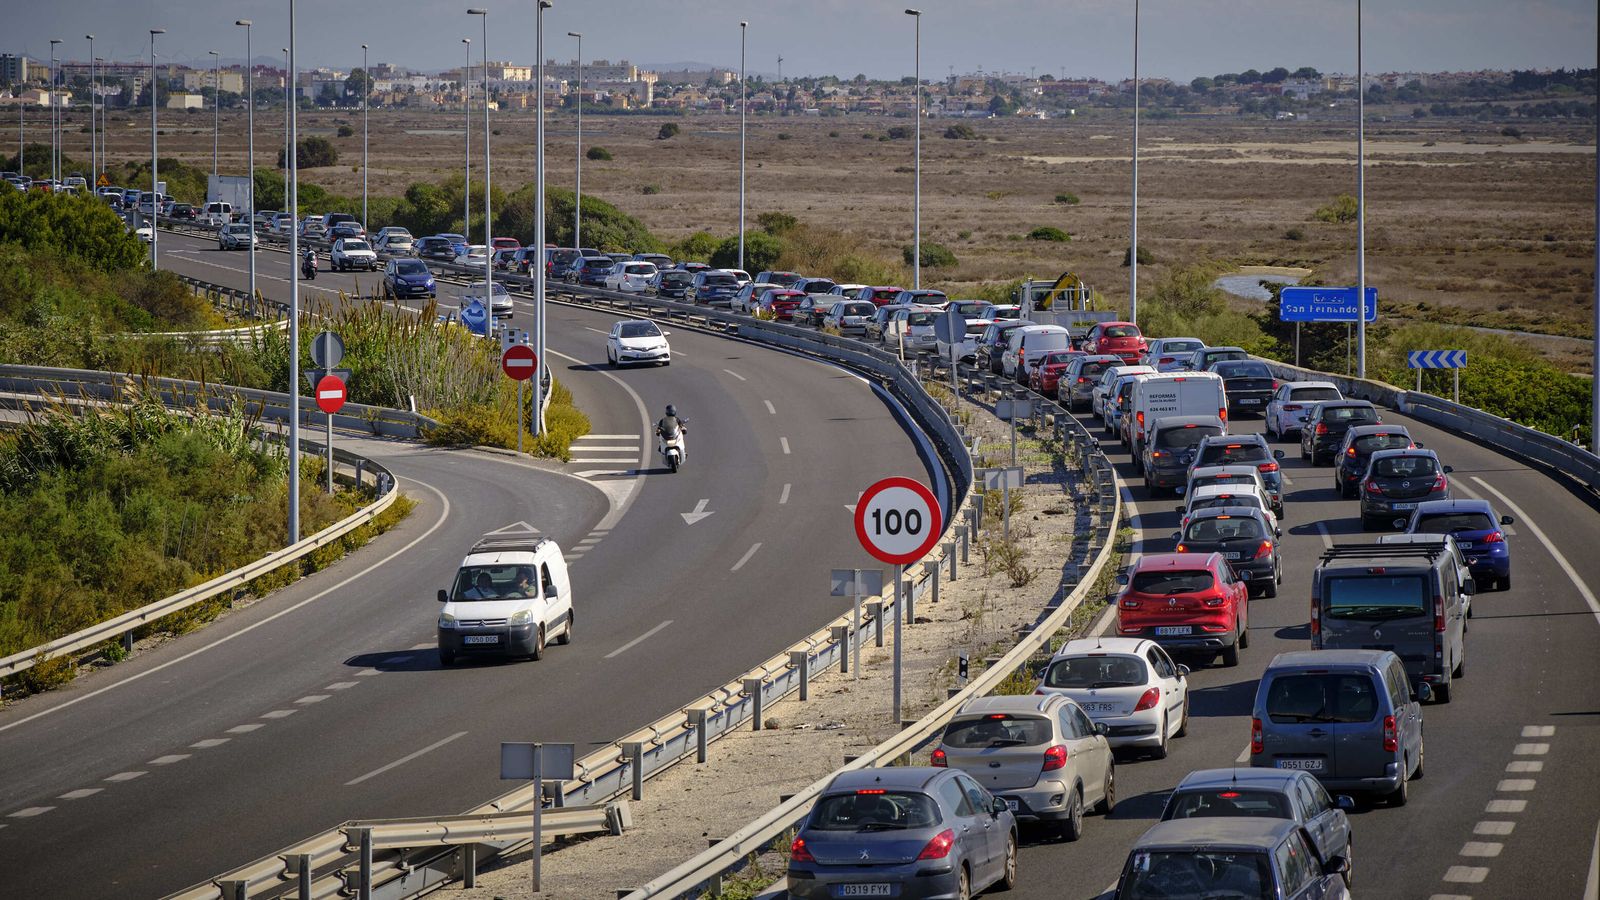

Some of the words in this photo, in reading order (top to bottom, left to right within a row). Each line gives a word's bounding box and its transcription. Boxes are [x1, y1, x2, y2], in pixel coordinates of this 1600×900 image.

[1286, 304, 1305, 313] San
[1310, 304, 1357, 314] Fernando
[872, 508, 922, 535] 100
[1281, 760, 1301, 769] 0551
[1304, 760, 1321, 769] GZJ
[845, 884, 869, 895] 0319
[871, 884, 889, 895] FYK
